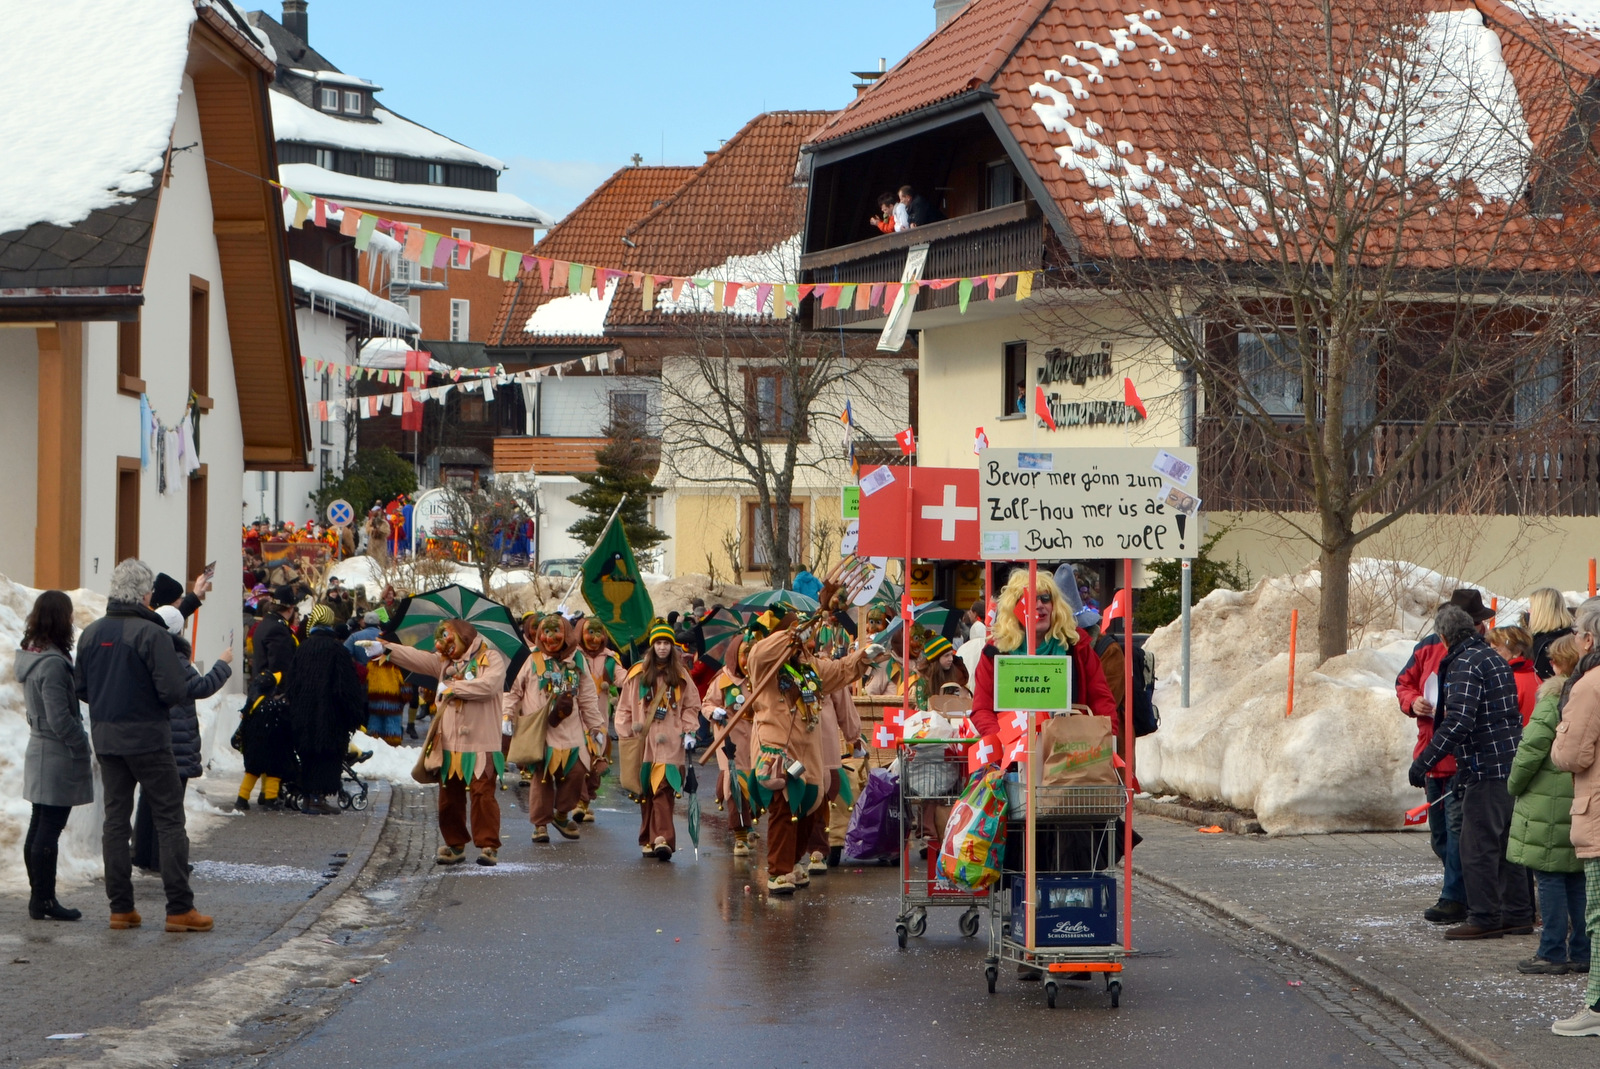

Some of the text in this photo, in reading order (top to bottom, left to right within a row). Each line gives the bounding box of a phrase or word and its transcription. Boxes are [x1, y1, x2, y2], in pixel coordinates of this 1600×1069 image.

[1037, 393, 1147, 429] immermann
[986, 460, 1163, 492] Bevor mer gönn zum
[1081, 503, 1112, 518] mer
[1024, 528, 1073, 552] Buch
[1082, 535, 1104, 548] no
[1014, 675, 1051, 683] PETER &
[1013, 686, 1051, 694] NORBERT
